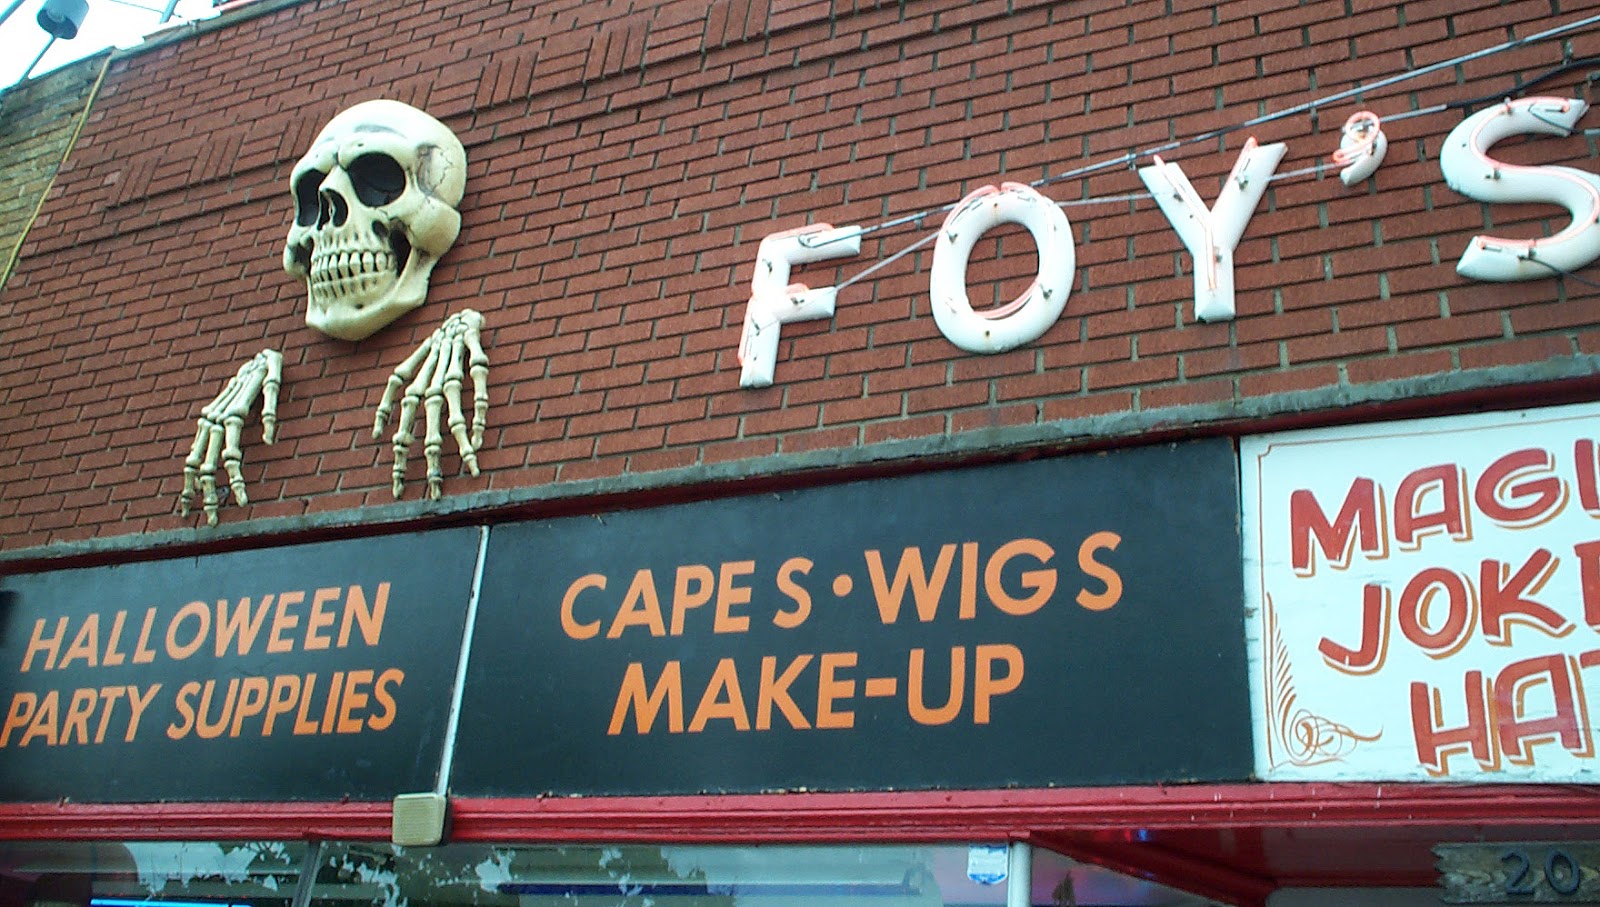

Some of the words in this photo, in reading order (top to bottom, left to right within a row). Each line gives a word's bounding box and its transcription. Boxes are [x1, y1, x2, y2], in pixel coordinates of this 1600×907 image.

[737, 96, 1600, 389] FOY'S
[20, 582, 391, 673] HALLOWEEN
[560, 557, 814, 642] CAPES
[864, 531, 1124, 626] WIGS
[0, 682, 163, 749] PARTY
[166, 668, 405, 740] SUPPLIES
[606, 643, 1025, 737] MAKE-UP
[1410, 649, 1600, 777] HA
[1501, 850, 1581, 895] 20
